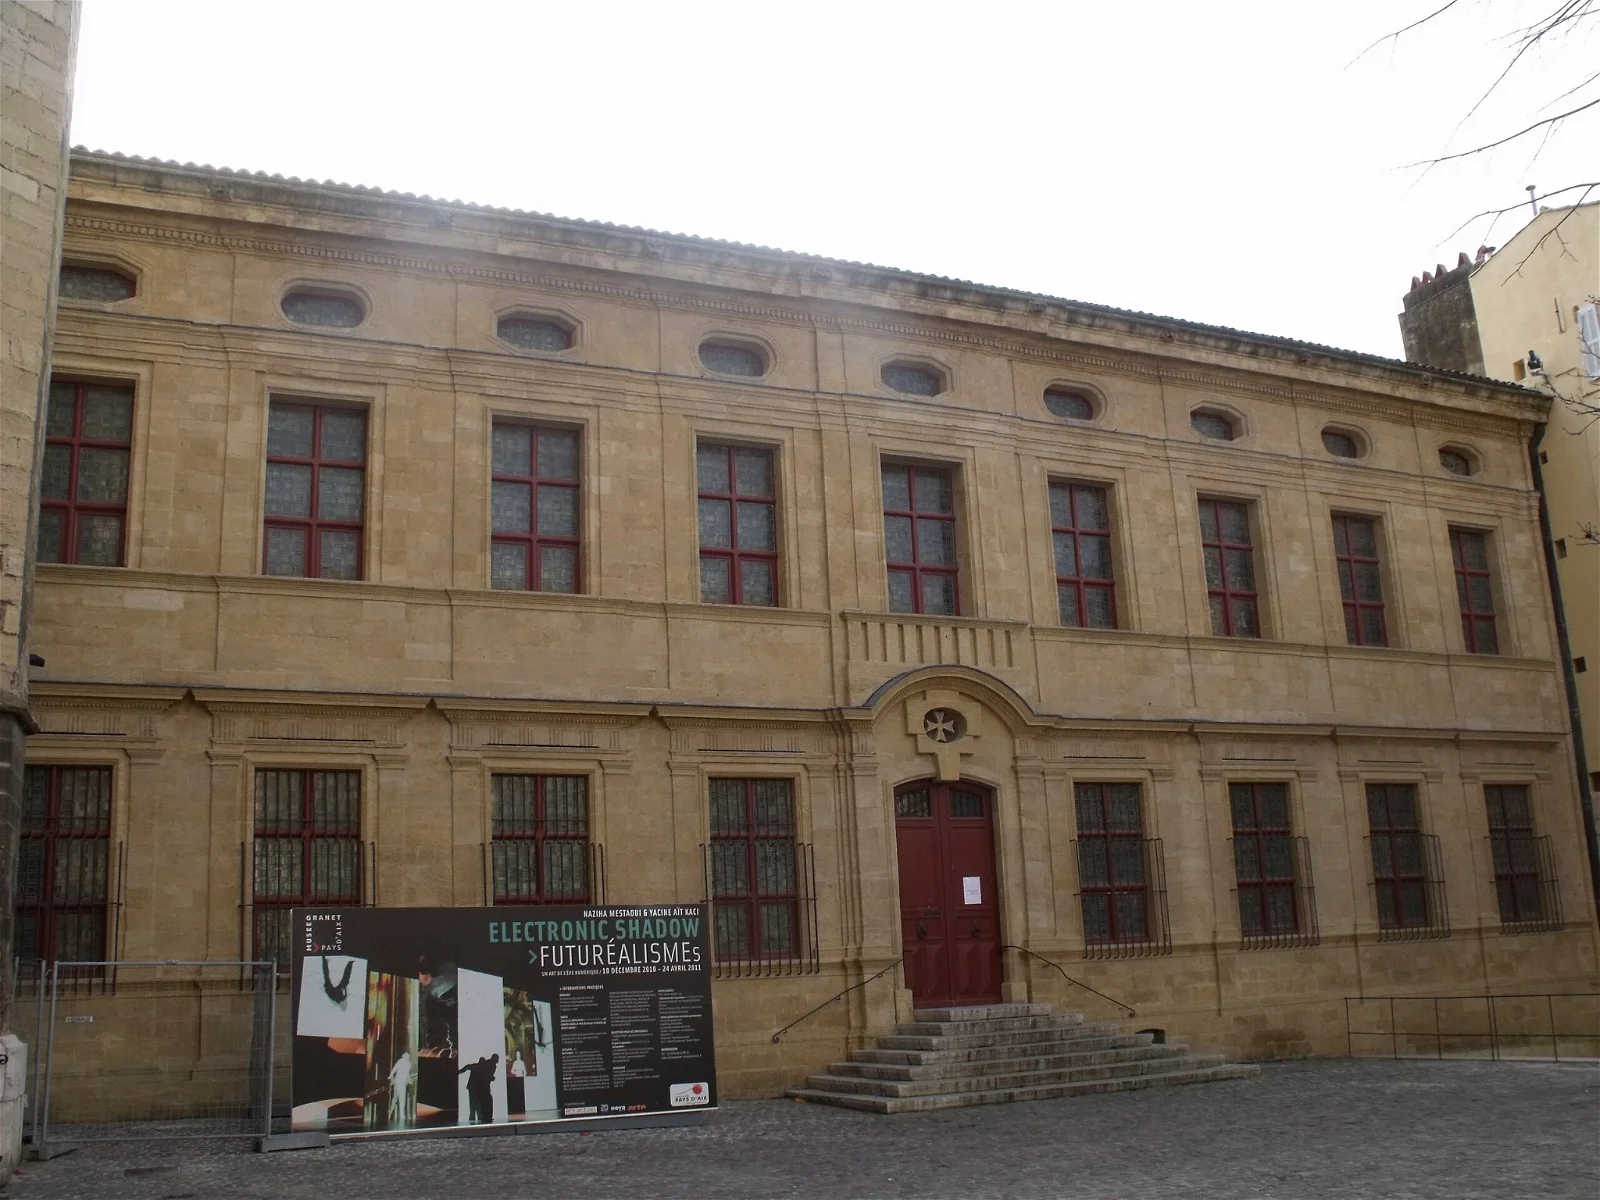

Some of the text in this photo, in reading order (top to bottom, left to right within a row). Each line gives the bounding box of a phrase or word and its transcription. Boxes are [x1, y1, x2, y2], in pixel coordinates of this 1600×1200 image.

[583, 907, 699, 918] NAZIHA MESTAOUI & YACINE AÏT KACI
[489, 917, 700, 943] ELECTRONIC SHADOW
[611, 966, 641, 974] DÉCEMBRE
[642, 965, 657, 973] 2010
[670, 964, 687, 972] AVRIL
